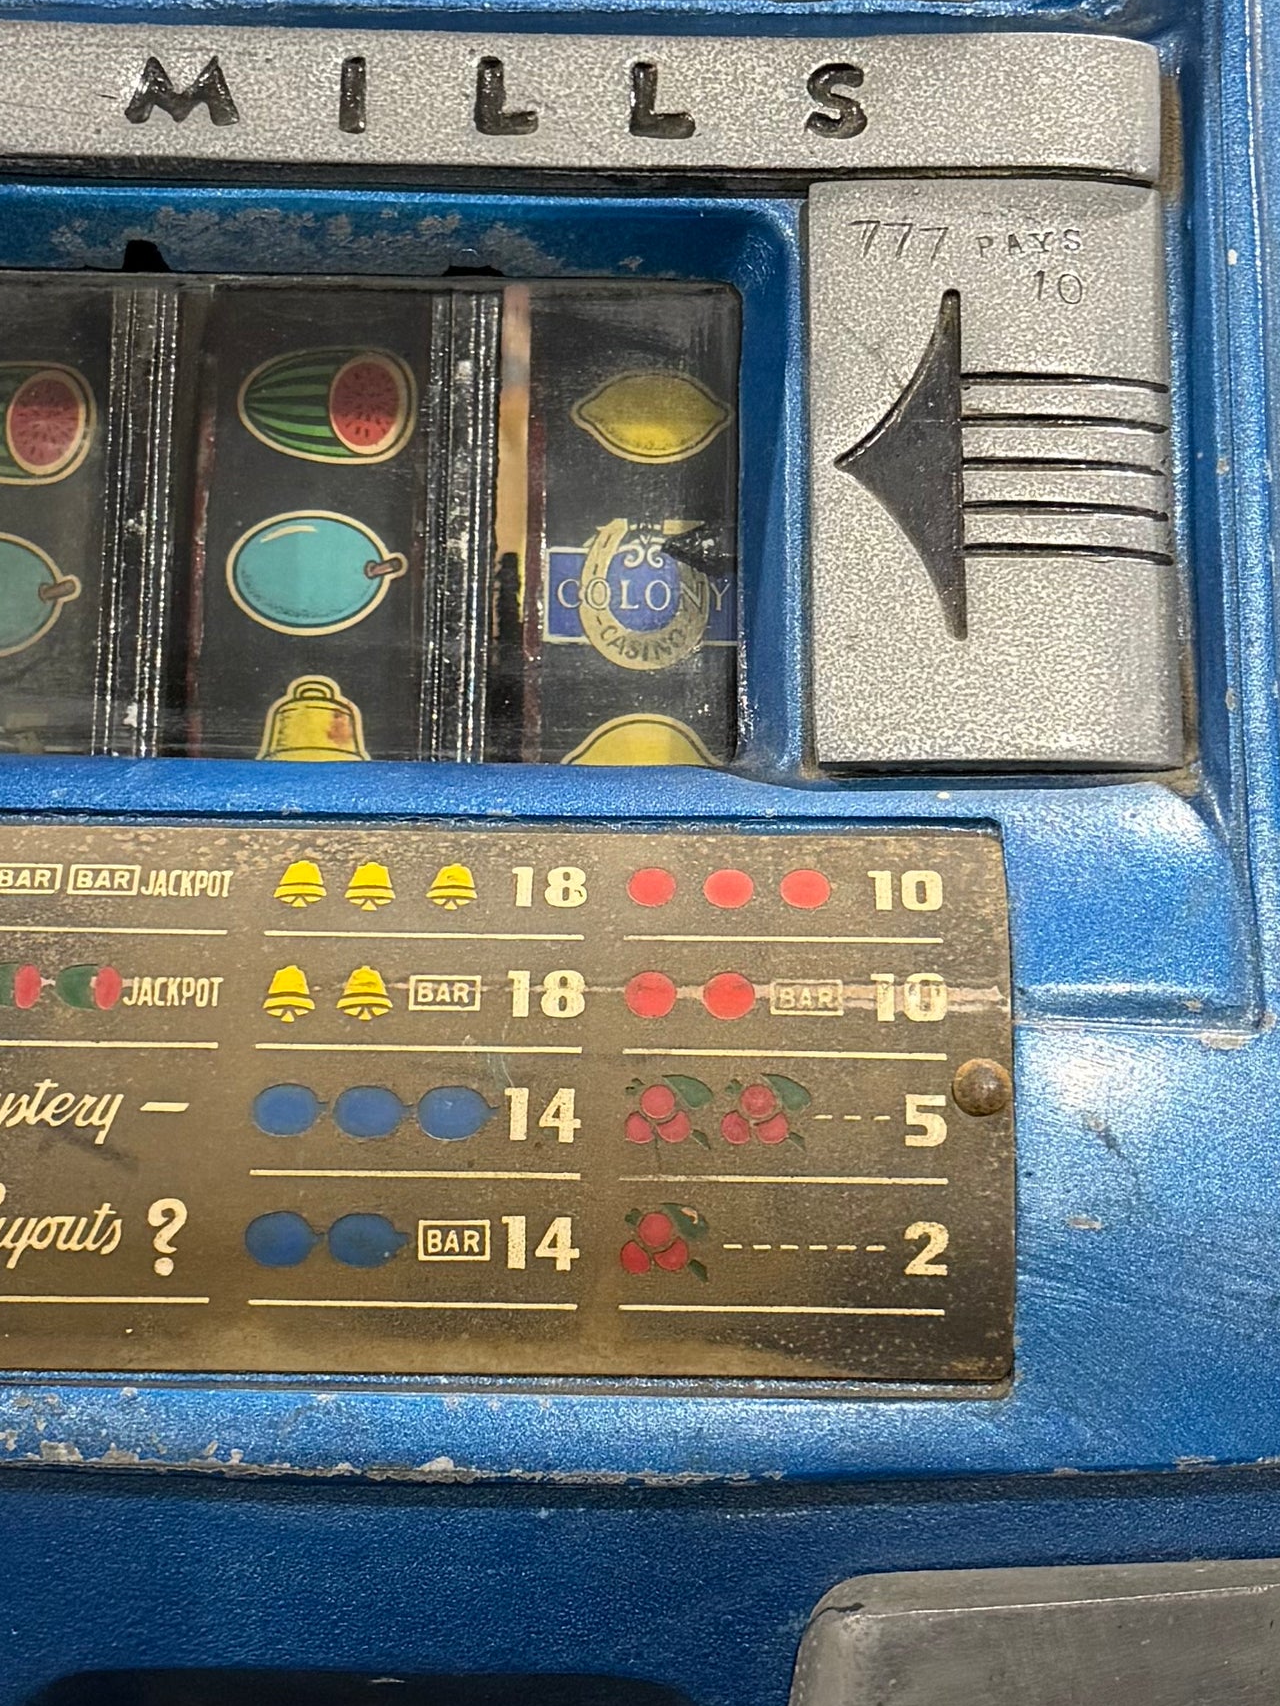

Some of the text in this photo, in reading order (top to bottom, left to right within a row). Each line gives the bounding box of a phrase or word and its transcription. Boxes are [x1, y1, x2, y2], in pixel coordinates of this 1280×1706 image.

[125, 55, 867, 138] MILLS
[848, 219, 1081, 260] 777 PAYS
[1033, 270, 1082, 305] 10
[557, 578, 731, 614] COLONY
[601, 625, 686, 661] CASINO
[76, 870, 131, 890] BAR
[141, 869, 233, 897] JACKPOT
[512, 866, 587, 908] 18
[867, 869, 943, 911] 10
[123, 976, 224, 1007] JACKPOT
[415, 982, 470, 1005] BAR
[507, 970, 585, 1018] 18
[775, 985, 835, 1010] BAR
[870, 973, 945, 1021] 10
[505, 1087, 581, 1143] 14
[904, 1094, 948, 1147] 5
[425, 1229, 481, 1254] BAR
[502, 1215, 579, 1271] 14
[903, 1221, 948, 1276] 2
